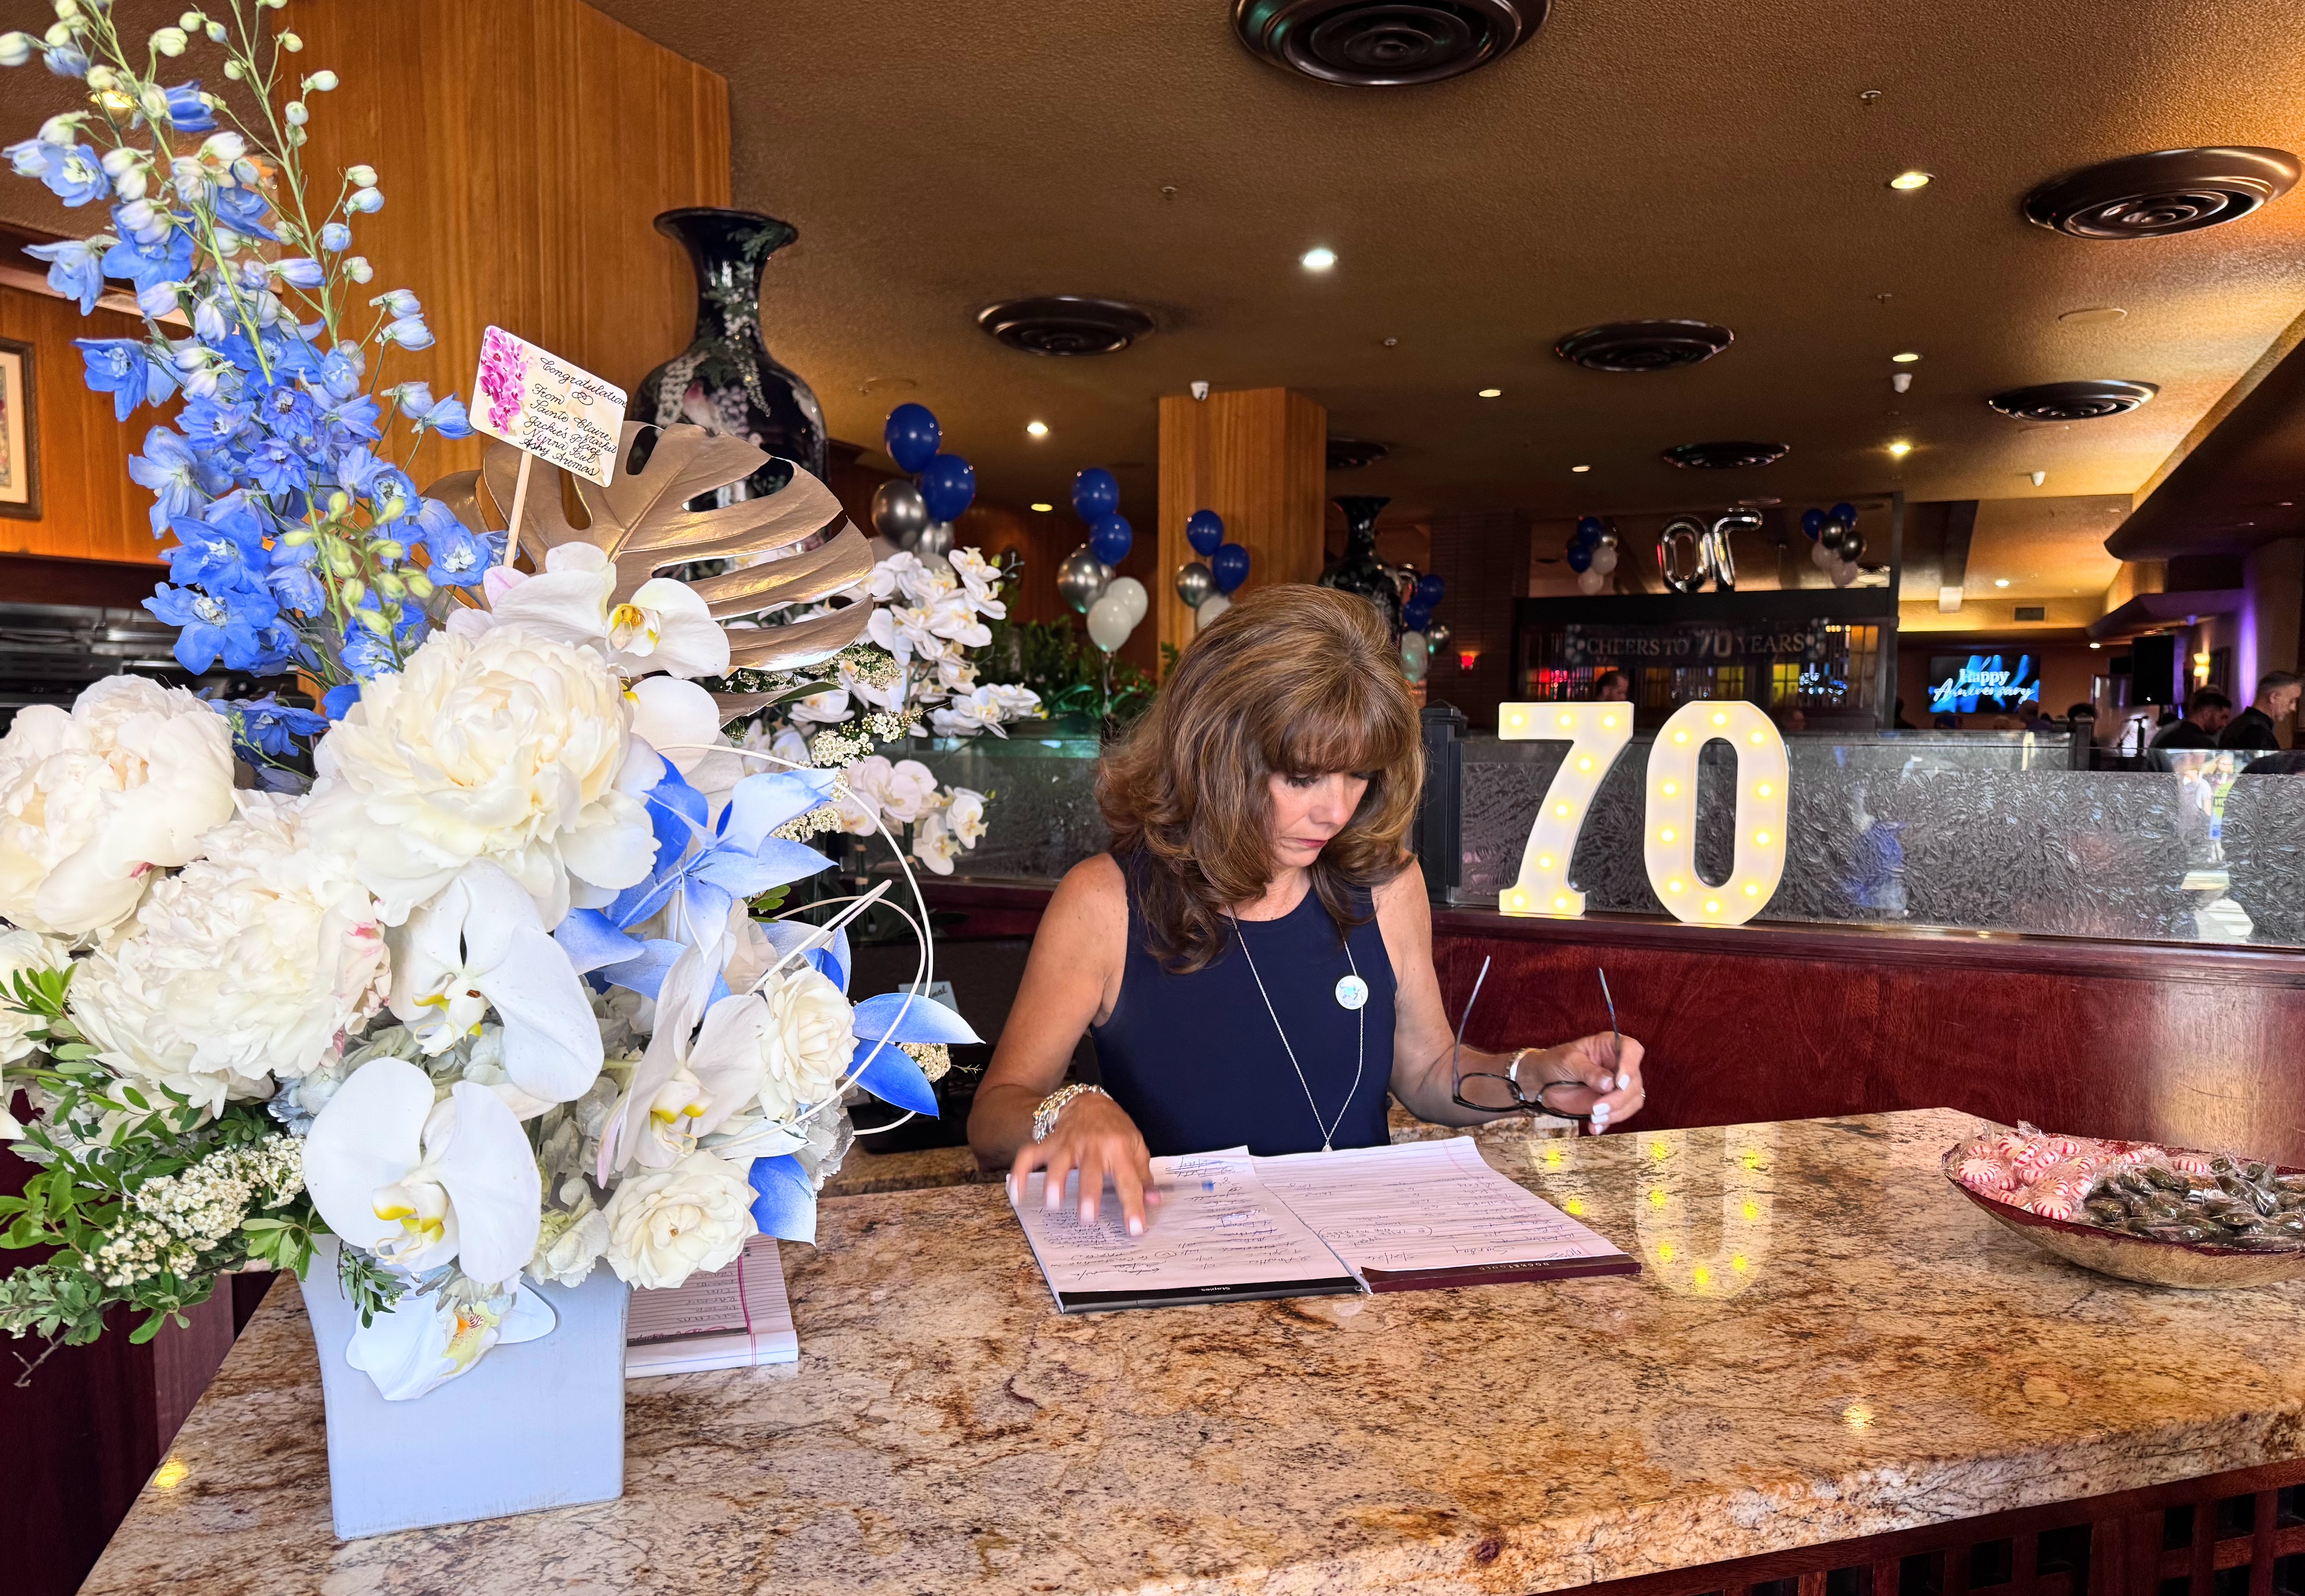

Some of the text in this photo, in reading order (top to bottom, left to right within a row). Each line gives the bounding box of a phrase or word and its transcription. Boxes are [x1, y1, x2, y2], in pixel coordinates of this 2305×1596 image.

[532, 383, 565, 405] From
[530, 400, 612, 441] Sainte Claire
[523, 416, 603, 456] Jackie's Place
[552, 452, 600, 476] Aromas
[569, 447, 596, 463] Soul
[1587, 629, 1805, 659] CHEERS TO 70 YEARS
[1959, 668, 2011, 686] Happy
[1933, 678, 2035, 705] Anniversary
[1499, 701, 1789, 925] 70
